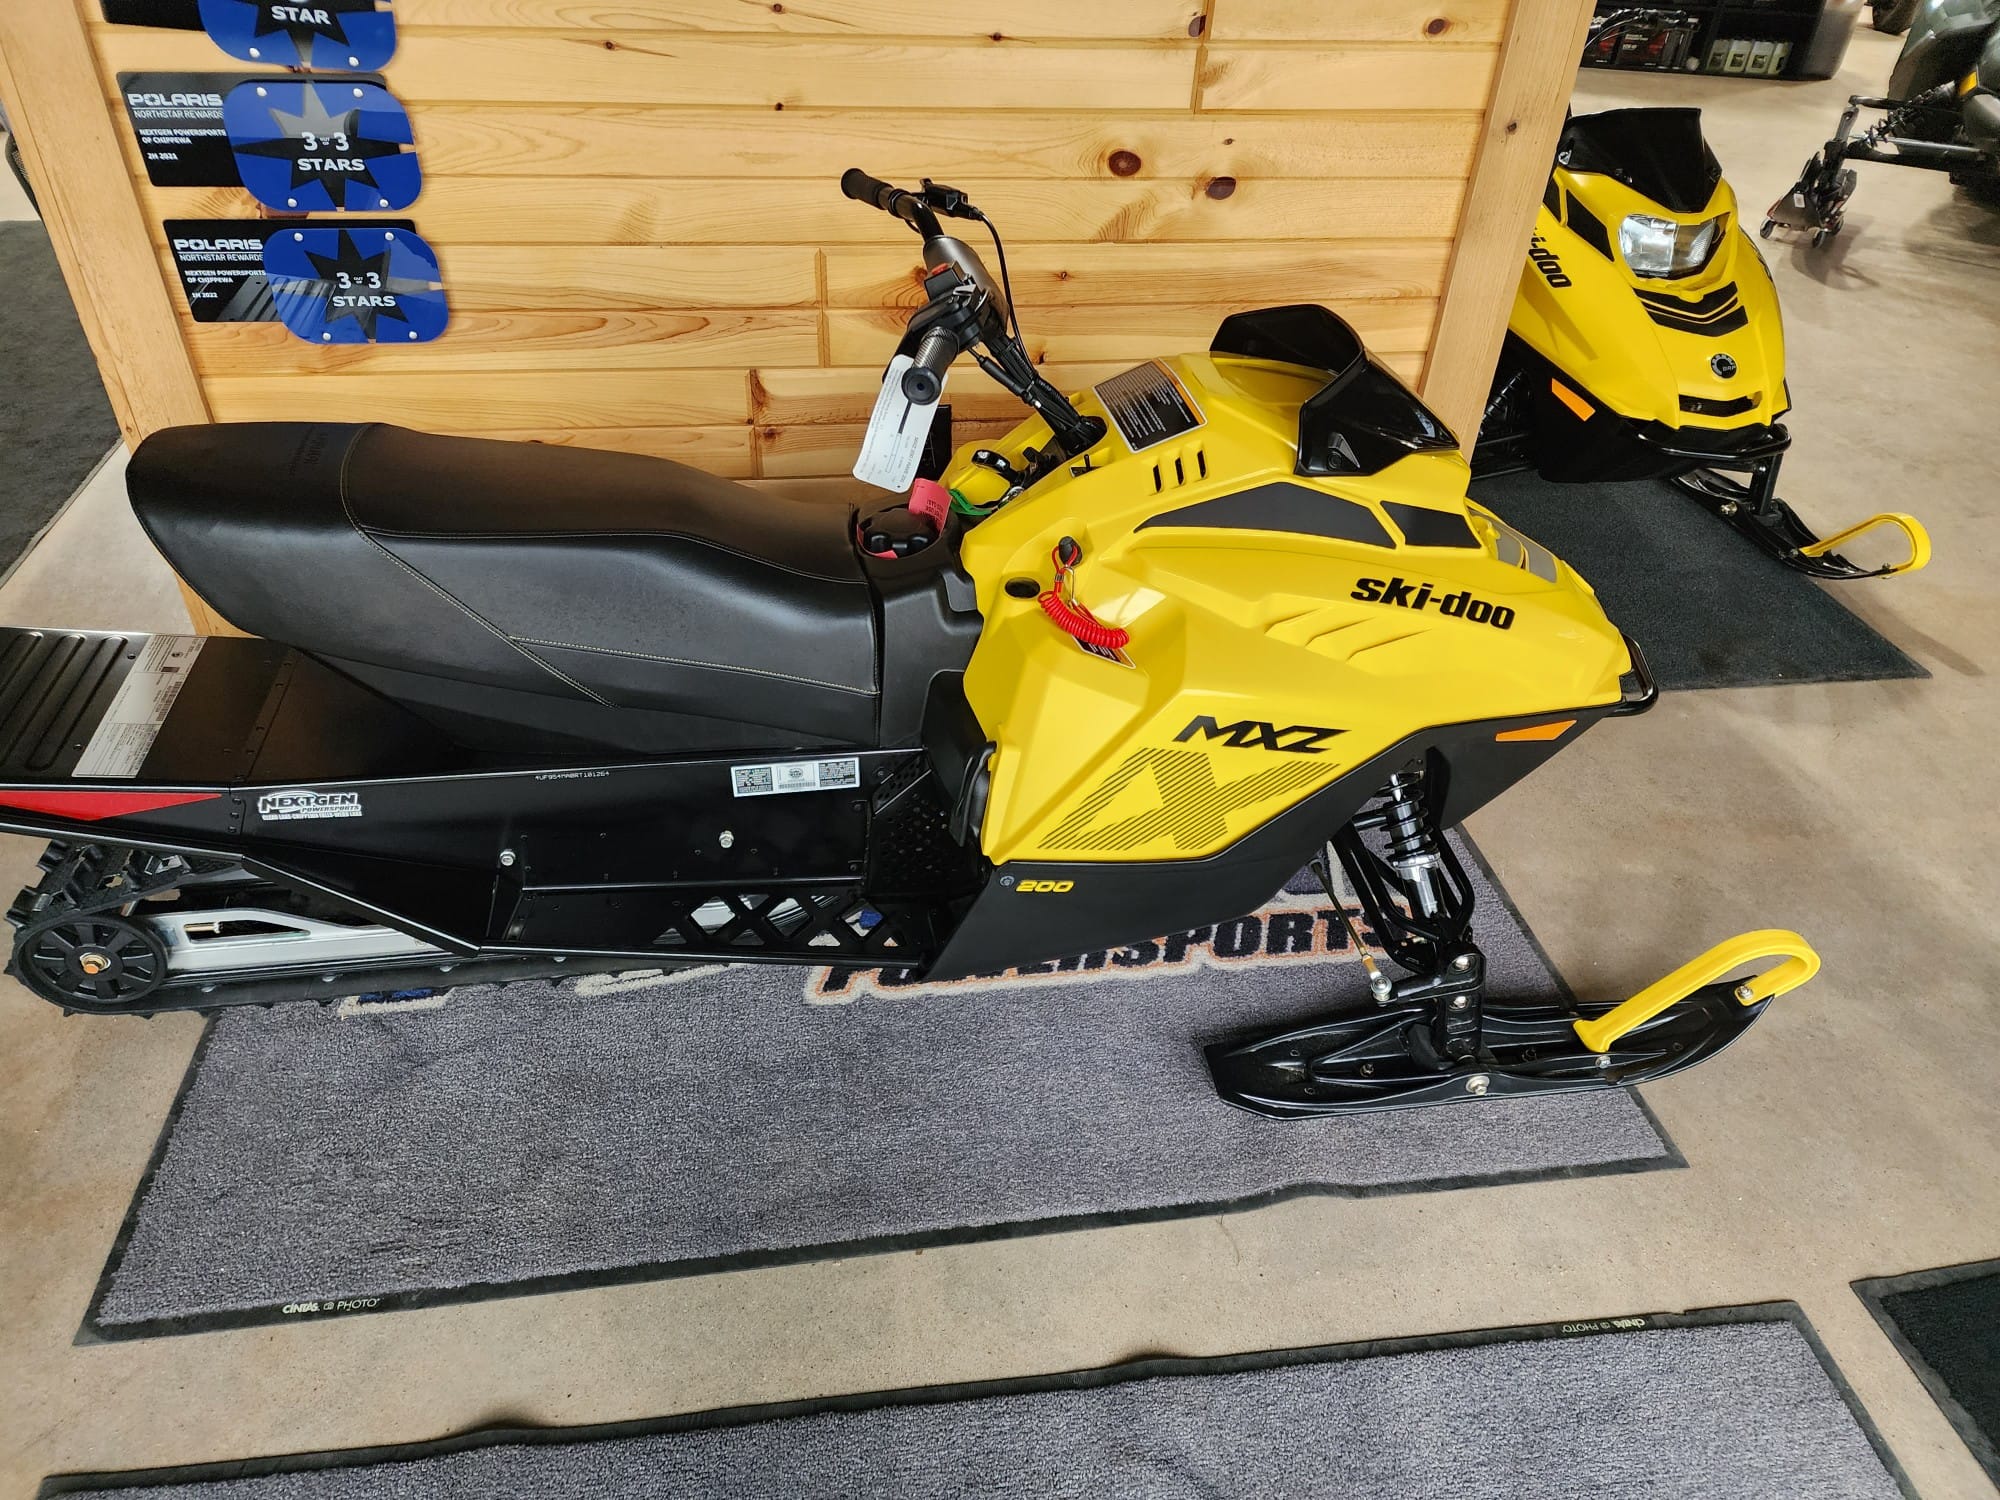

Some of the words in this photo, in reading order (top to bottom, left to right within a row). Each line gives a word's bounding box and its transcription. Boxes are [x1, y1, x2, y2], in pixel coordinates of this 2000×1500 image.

[270, 5, 332, 25] STAR
[127, 93, 223, 107] POLARIS
[133, 110, 183, 120] NORTHSTAR
[184, 110, 225, 120] REWARDS
[302, 131, 318, 151] 3
[333, 131, 350, 151] 3
[297, 158, 366, 171] STARS
[173, 239, 263, 250] POLARIS
[179, 253, 225, 262] NORTHSTAR
[226, 253, 264, 262] REWARDS
[336, 271, 352, 289] 3
[366, 271, 382, 289] 3
[332, 295, 397, 307] STARS
[1350, 577, 1516, 630] ski-doo
[1172, 714, 1352, 754] MXZ
[301, 805, 361, 813] POWERSPORTS
[1015, 879, 1075, 893] 200
[337, 1299, 378, 1311] PHOTO
[1561, 1323, 1599, 1333] PHOTO
